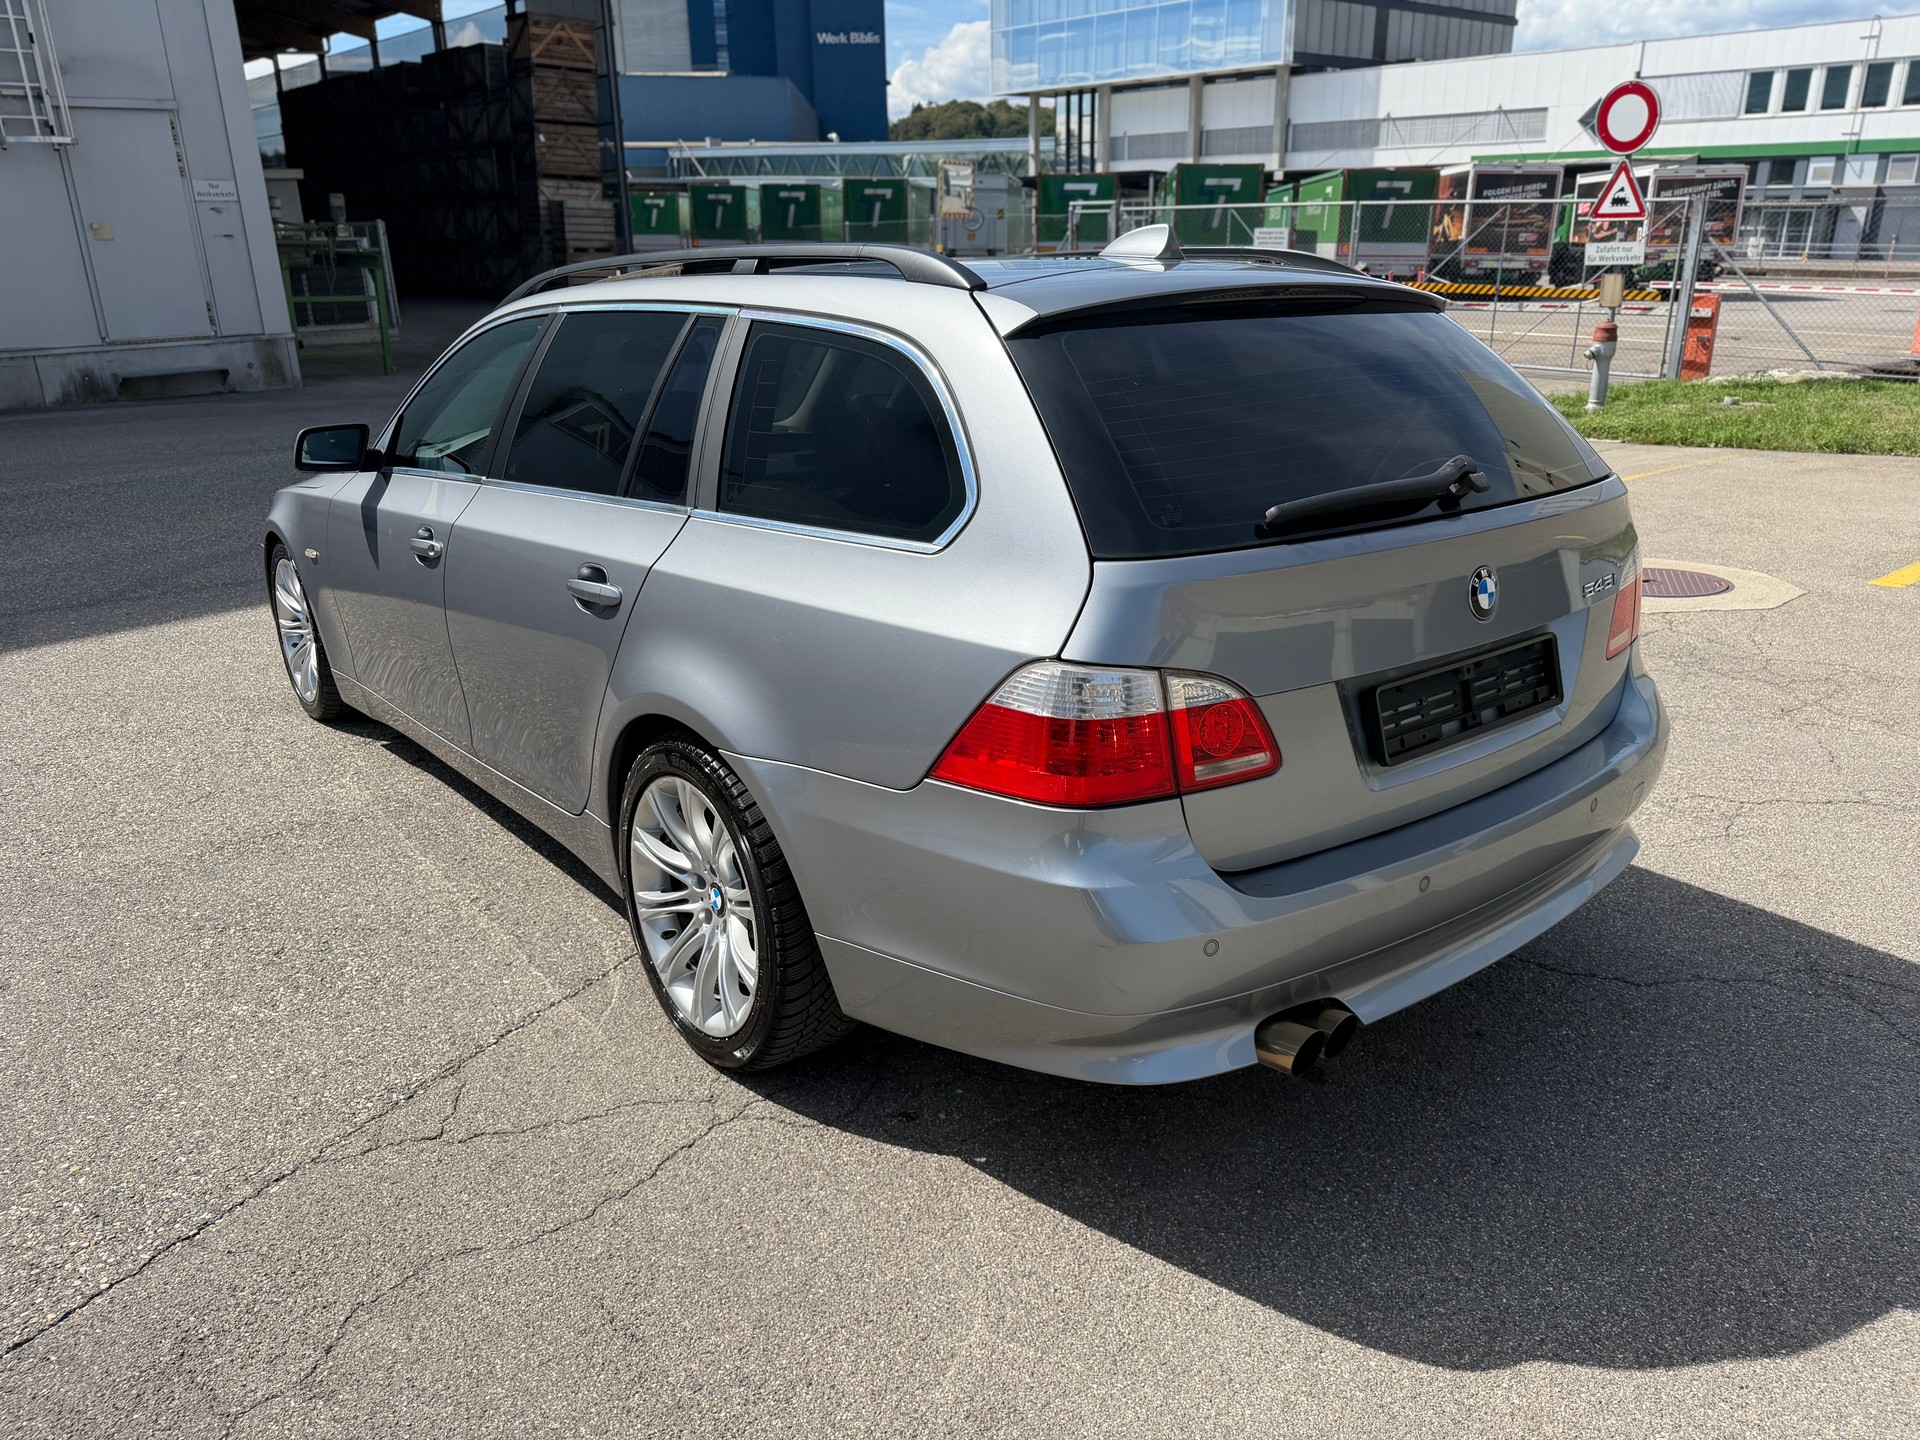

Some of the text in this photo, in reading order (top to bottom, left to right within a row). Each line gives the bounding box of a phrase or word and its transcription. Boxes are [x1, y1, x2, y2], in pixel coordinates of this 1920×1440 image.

[816, 32, 880, 44] Werk Biblis
[1482, 182, 1548, 197] FOLGEN SIE IHREM
[1660, 190, 1673, 198] DIE
[1673, 183, 1712, 196] HERKUNFT
[1598, 254, 1641, 262] Werkverkehr
[1472, 569, 1497, 588] BMW
